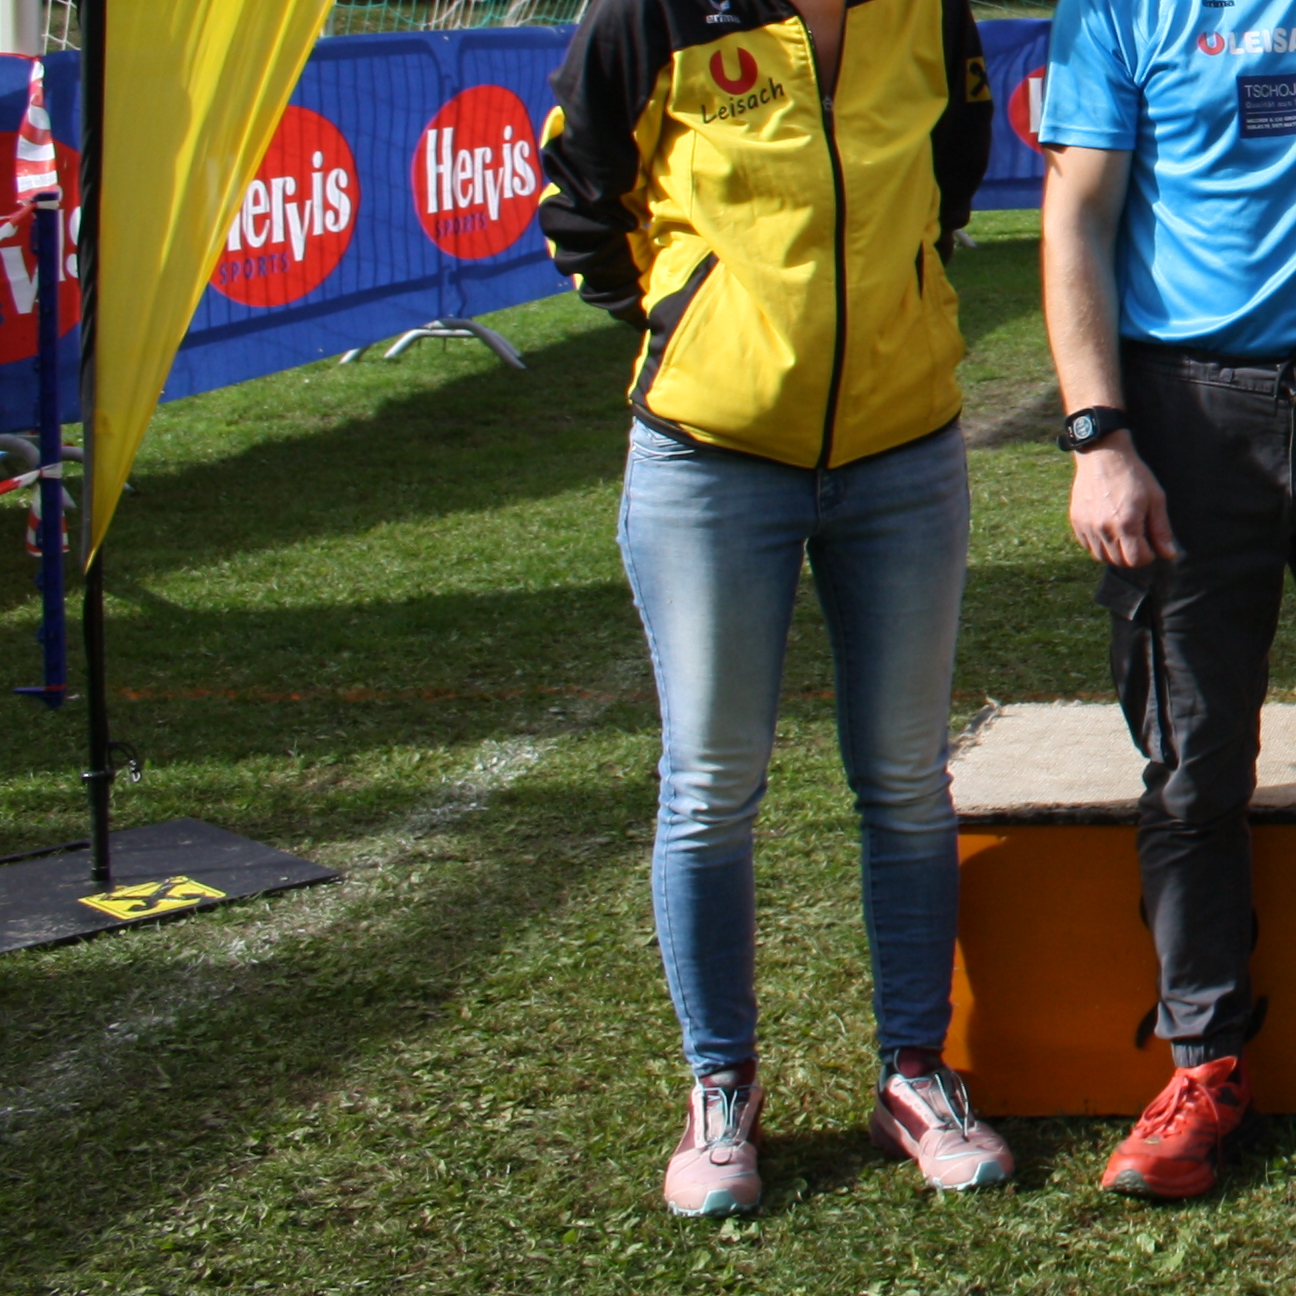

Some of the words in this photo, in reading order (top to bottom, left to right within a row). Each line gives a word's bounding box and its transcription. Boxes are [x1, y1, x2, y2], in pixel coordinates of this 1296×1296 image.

[701, 76, 785, 124] Leisach
[426, 125, 537, 221] Hervis
[436, 211, 487, 239] SPORTS
[219, 253, 290, 285] SPORTS
